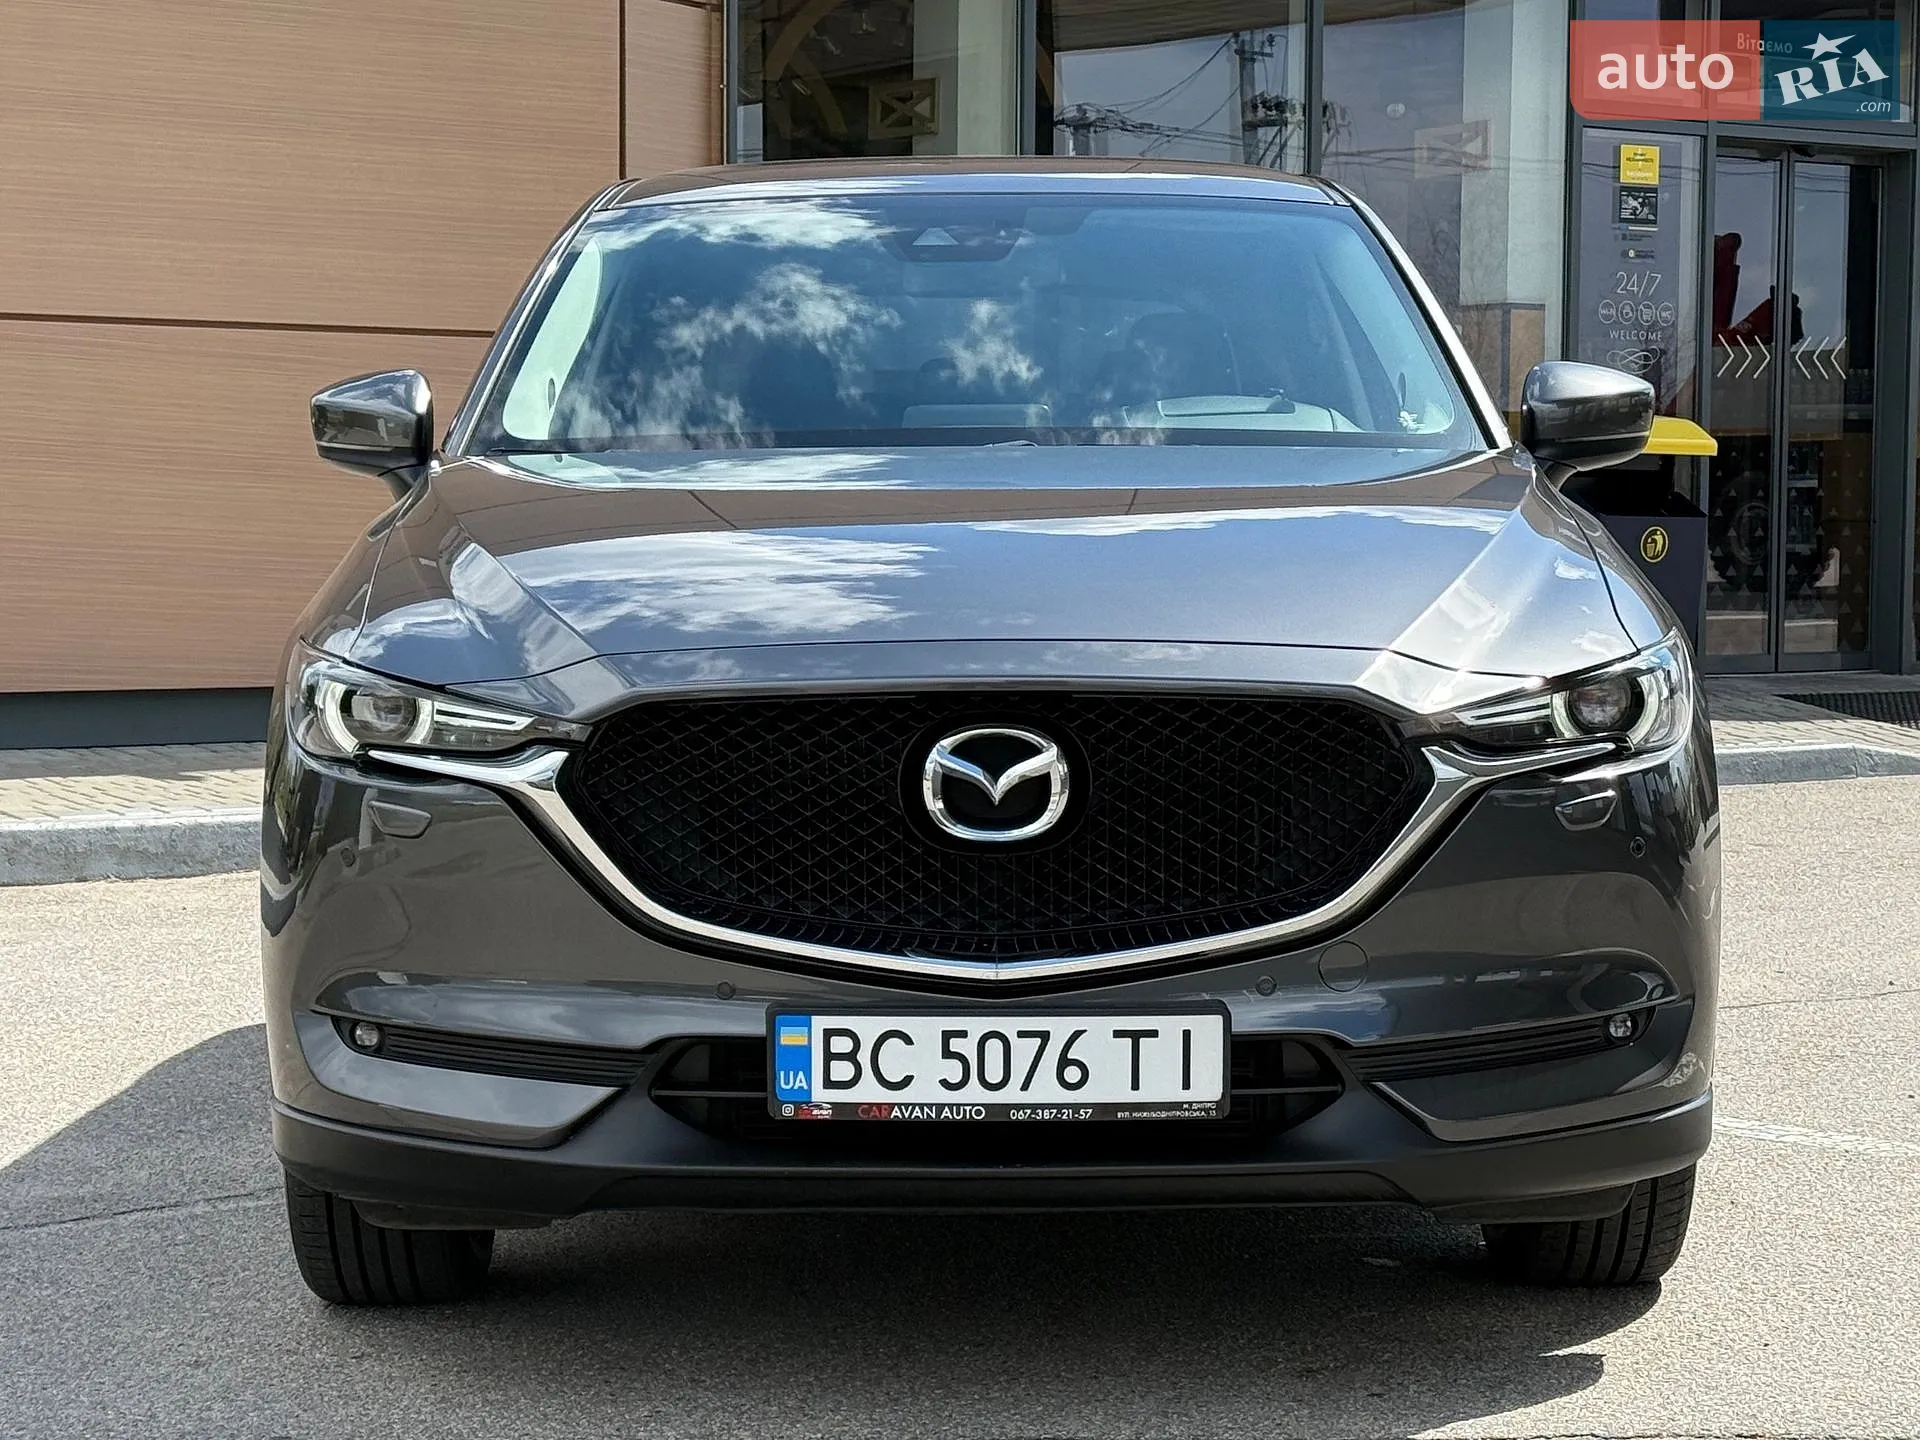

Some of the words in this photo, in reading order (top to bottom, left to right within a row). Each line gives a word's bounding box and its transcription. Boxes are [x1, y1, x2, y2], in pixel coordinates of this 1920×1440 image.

[1736, 32, 1793, 54] Вітаємо
[1616, 271, 1662, 298] 24/7
[1608, 329, 1663, 342] WELCOME
[822, 1028, 915, 1091] BC
[938, 1029, 1091, 1092] 5076
[780, 1070, 809, 1091] UA
[857, 1105, 936, 1120] CARAVAN
[940, 1105, 986, 1120] AUTO
[1009, 1108, 1094, 1121] 067-387-21-57
